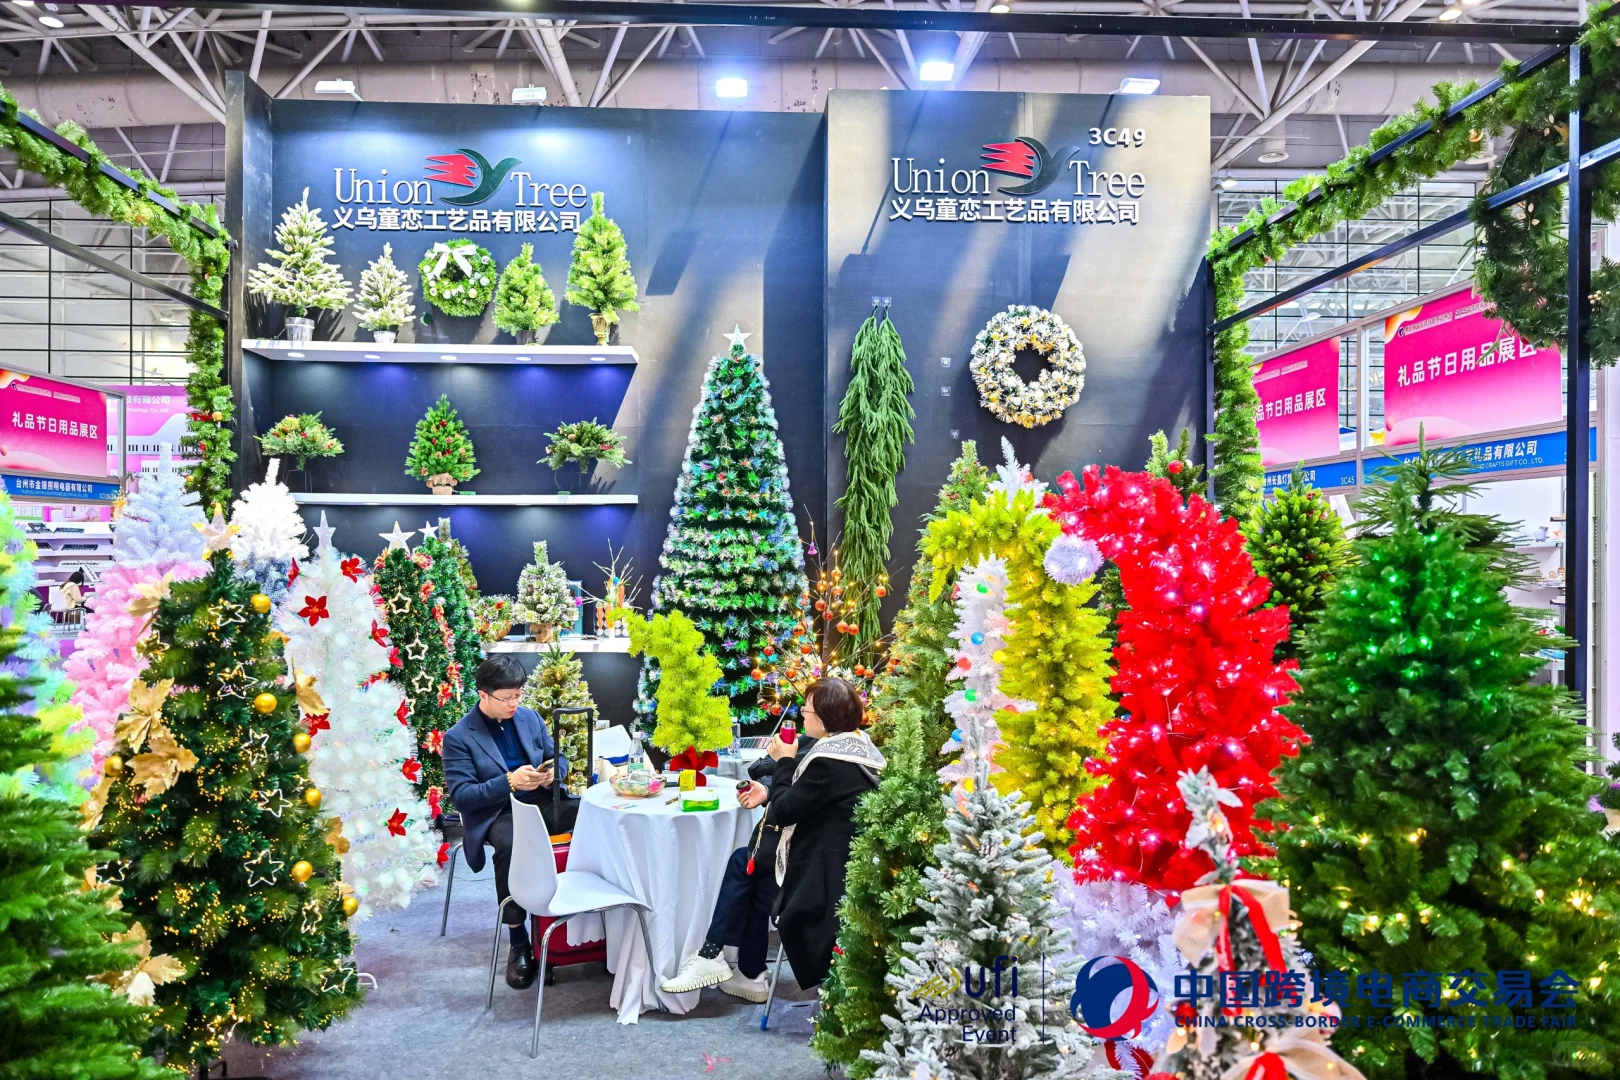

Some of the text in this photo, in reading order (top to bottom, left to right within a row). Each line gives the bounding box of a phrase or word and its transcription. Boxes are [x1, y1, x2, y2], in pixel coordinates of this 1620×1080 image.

[1088, 127, 1147, 148] 3C49
[334, 168, 588, 208] Union Tree
[891, 158, 1147, 197] Union Tree
[331, 206, 582, 233] 义乌童恋工艺品有限公司
[889, 197, 1140, 224] 义乌童恋工艺品有限公司
[1397, 336, 1537, 388] 礼品节日用品展区
[1256, 387, 1326, 422] 品节日用品展区
[12, 411, 98, 439] 礼品节日用品展区
[1340, 475, 1355, 485] 3C45
